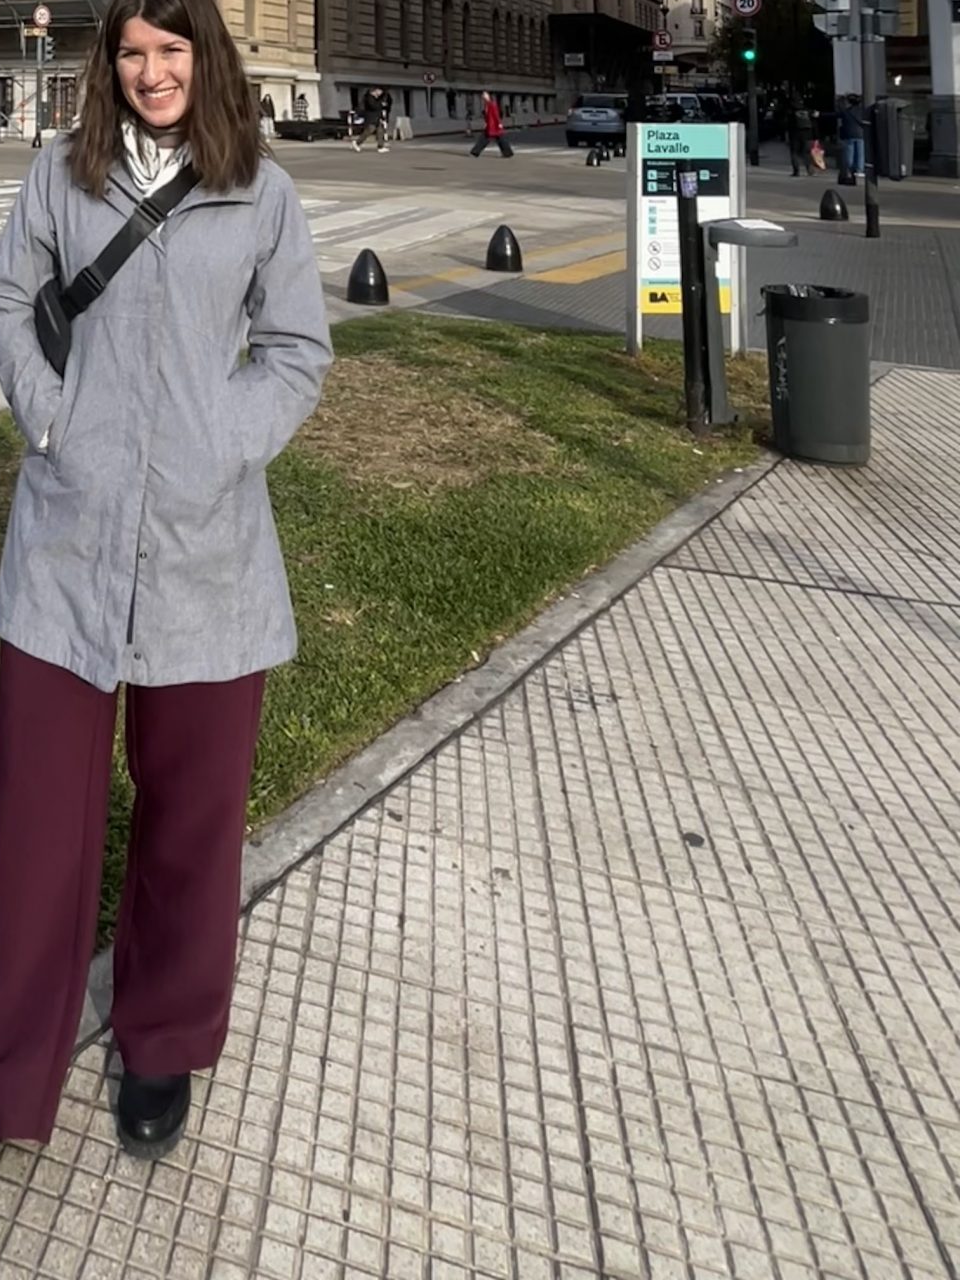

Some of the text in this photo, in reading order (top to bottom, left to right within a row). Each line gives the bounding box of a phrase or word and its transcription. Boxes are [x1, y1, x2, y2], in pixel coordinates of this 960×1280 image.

[647, 130, 680, 140] Plaza
[647, 143, 690, 153] Lavalle
[649, 292, 669, 303] BA
